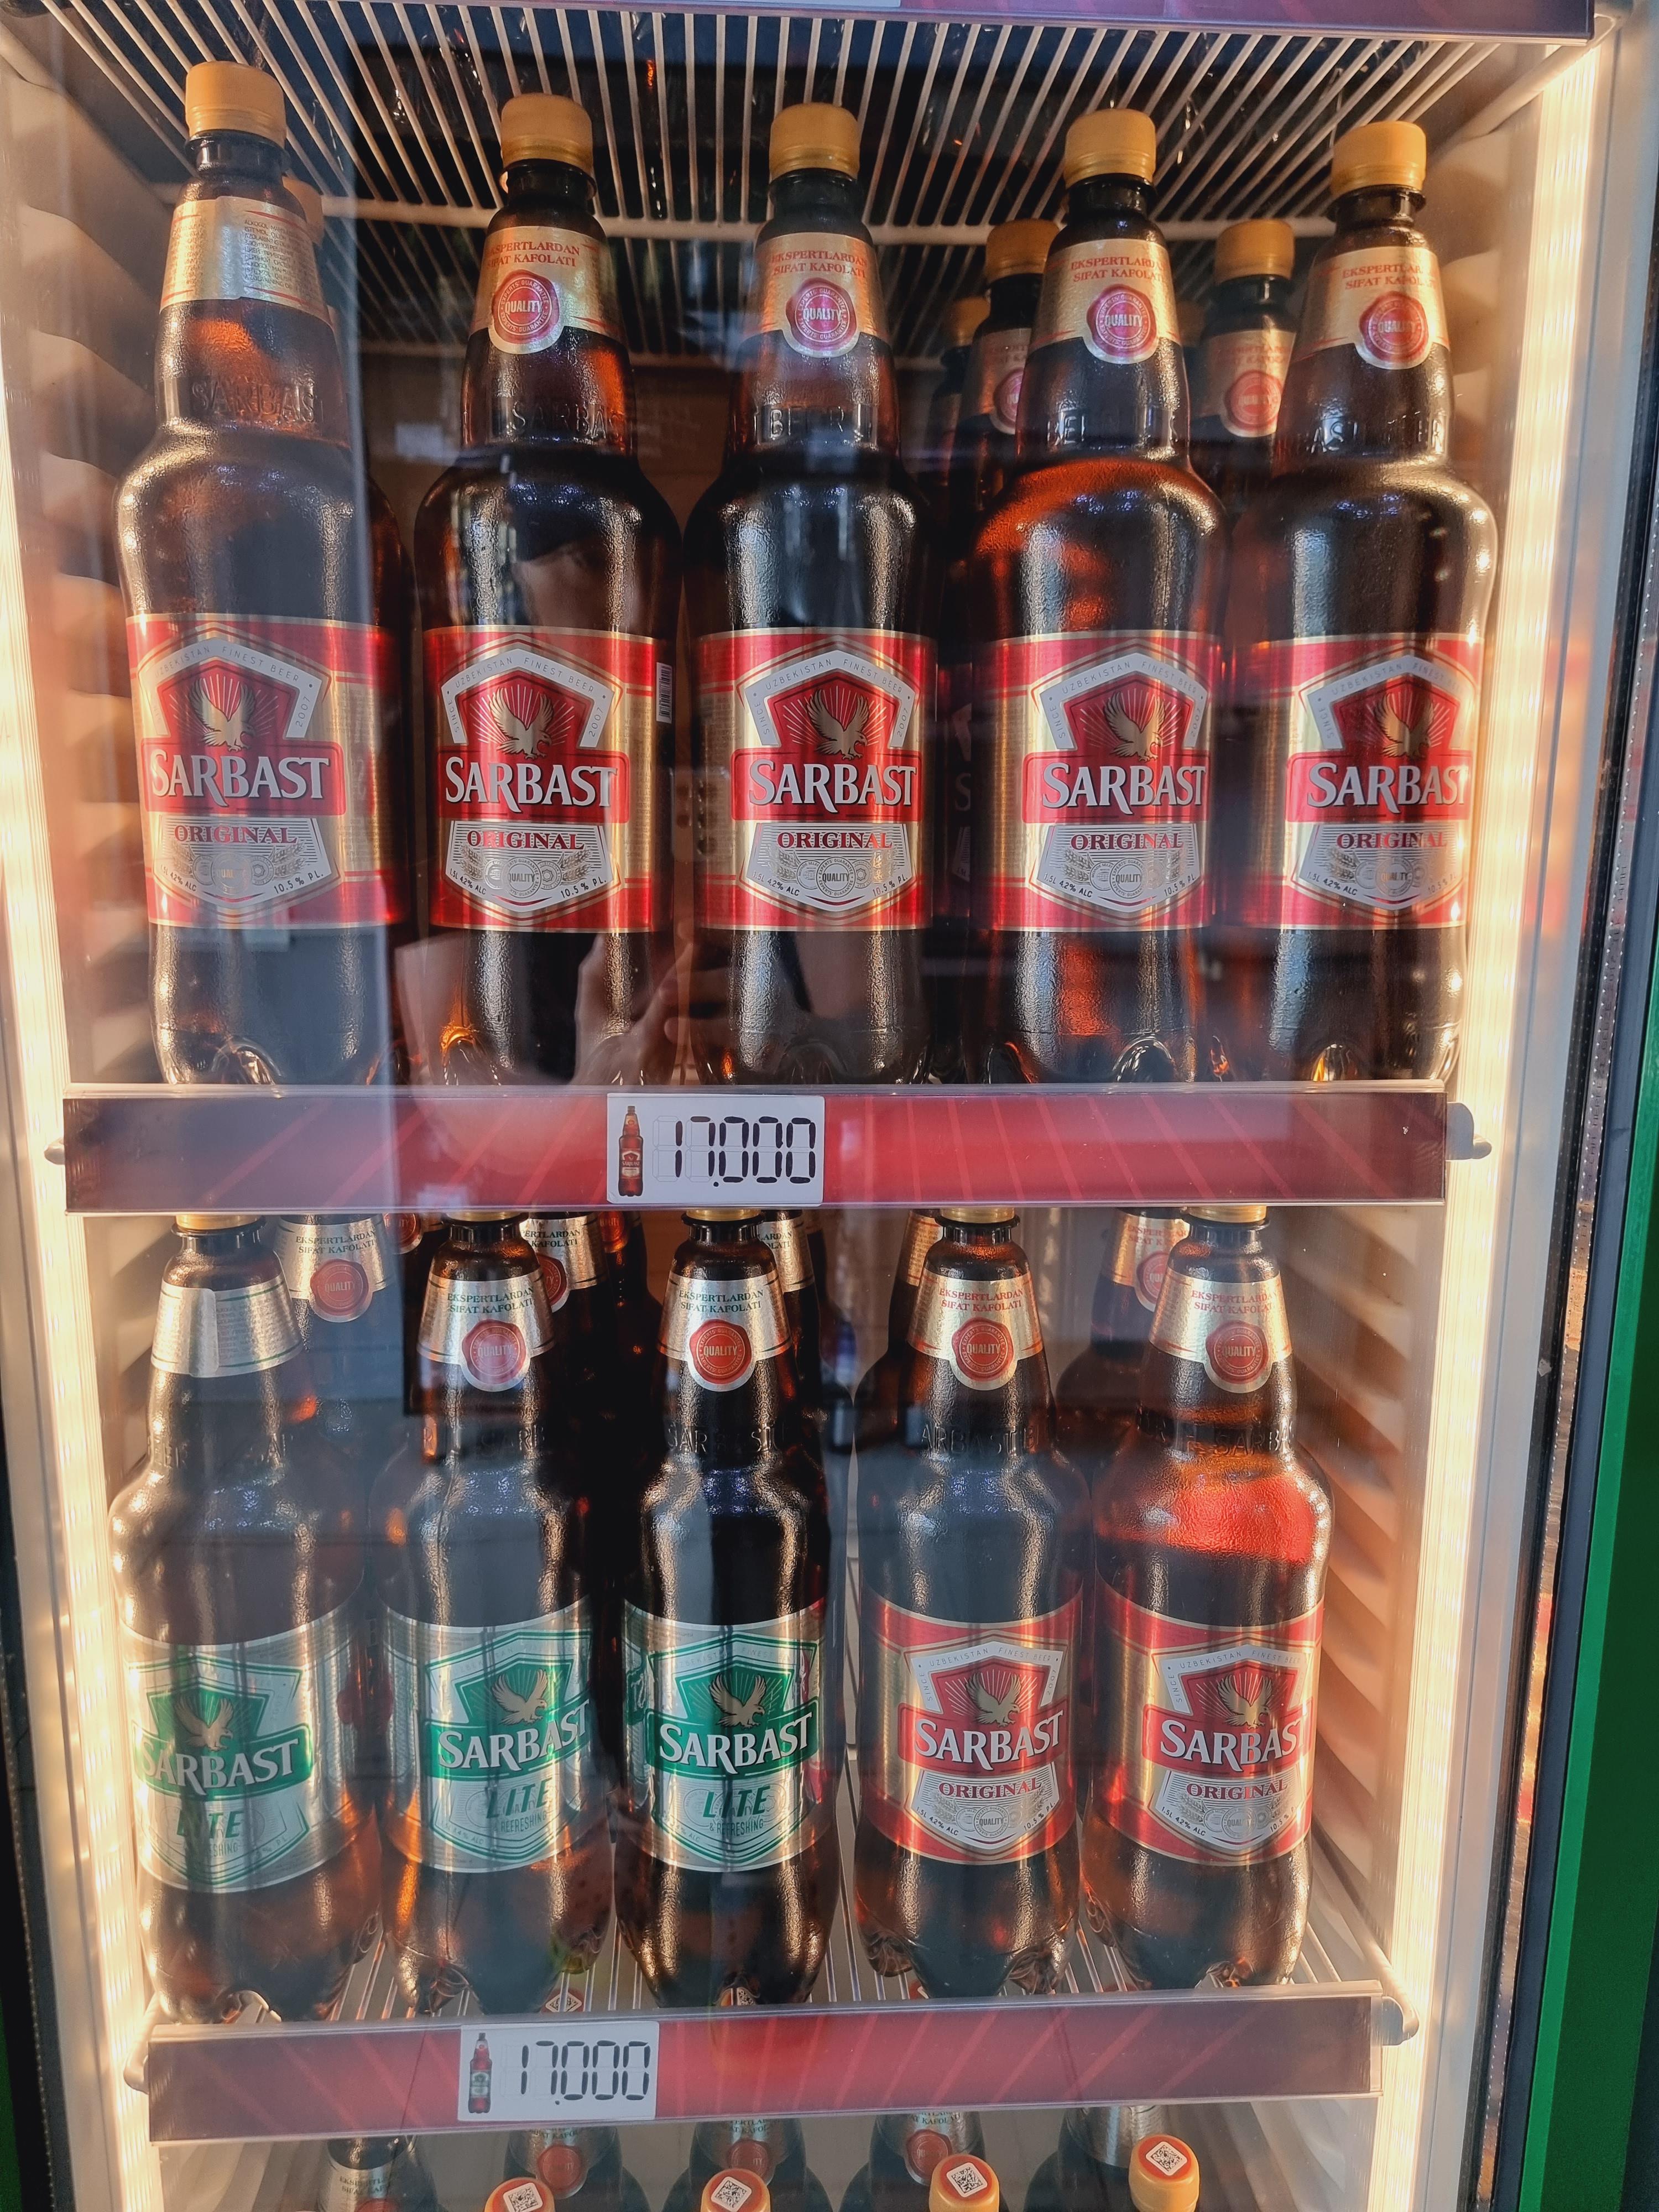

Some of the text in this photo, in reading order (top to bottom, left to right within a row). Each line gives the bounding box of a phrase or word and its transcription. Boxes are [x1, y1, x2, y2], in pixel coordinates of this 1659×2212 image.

[513, 253, 577, 267] KAFOLATI
[773, 262, 865, 278] SIFAT KAFOLATI
[1073, 269, 1109, 282] SIFAT
[1345, 277, 1381, 290] SIFAT
[521, 280, 550, 304] GUARANTEE
[504, 300, 544, 315] QUALITY
[802, 307, 843, 322] QUALITY
[1104, 314, 1144, 328] QUALITY
[154, 646, 300, 682] UZBEKISTAN FINEST BEER
[455, 657, 594, 693] UZBEKISTAN FINEST BEER
[765, 659, 903, 693] UZBEKISTAN FINEST BEER
[1062, 661, 1130, 695] UZBEKISTAN
[1141, 661, 1176, 680] FINEST
[1331, 664, 1403, 695] UZBEKISTAN
[294, 696, 311, 728] 2007
[447, 699, 461, 733] SINCE
[753, 702, 771, 735] SINCE
[588, 708, 604, 738] 2007
[896, 708, 909, 737] 2007
[1050, 706, 1067, 739] SINCE
[1318, 707, 1335, 739] SINCE
[149, 748, 332, 807] SARBAST
[445, 756, 619, 813] SARBAST
[748, 758, 917, 813] SARBAST
[1041, 762, 1207, 816] SARBAST
[1306, 762, 1471, 816] SARBAST
[174, 825, 298, 844] ORIGINAL
[466, 830, 585, 850] ORIGINAL
[776, 832, 894, 849] ORIGINAL
[1070, 832, 1185, 851] ORIGINAL
[1335, 832, 1448, 849] ORIGINAL
[185, 881, 197, 892] ALC
[273, 880, 295, 895] 10.5
[294, 877, 306, 885] %
[449, 868, 459, 880] 1.5L
[474, 885, 488, 895] ALC
[507, 872, 536, 883] QUALITY
[752, 870, 801, 896] 1.5L 4.2% ALC
[821, 873, 851, 883] QUALITY
[1043, 873, 1093, 898] 1.5L 4.2% ALC
[1115, 873, 1143, 883] QUALITY
[560, 877, 607, 899] 10.5 % PL.
[872, 884, 889, 897] 10.5
[1163, 883, 1179, 897] 10.5
[1343, 885, 1359, 896] ALC
[295, 1229, 376, 1244] EKSPERTLARDAN
[531, 1239, 578, 1248] KAFOLATI
[327, 1240, 375, 1254] KAFOLATI
[447, 1287, 534, 1303] EKSPERTLARDAN
[679, 1290, 764, 1302] EKSPERTLARDAN
[938, 1288, 1024, 1301] EKSPERTLARDAN
[449, 1298, 533, 1313] SIFAT KAFOLATI
[680, 1301, 761, 1313] SIFAT KAFOLATI
[941, 1300, 1022, 1312] SIFAT KAFOLATI
[1193, 1302, 1225, 1313] SIFAT
[477, 1344, 515, 1358] QUALITY
[703, 1345, 739, 1358] QUALITY
[967, 1343, 1002, 1356] QUALITY
[1222, 1346, 1258, 1358] QUALITY
[929, 1647, 989, 1667] UZBEKISTAN
[998, 1647, 1030, 1658] FINEST
[1179, 1650, 1282, 1669] UZBEKISTAN FINEST
[919, 1671, 934, 1702] SINCE
[1168, 1674, 1183, 1703] SINCE
[437, 1699, 591, 1771] SARBAST
[659, 1712, 813, 1775] SARBAST
[914, 1710, 1063, 1771] SARBAST
[1160, 1719, 1307, 1772] SARBAST
[139, 1739, 300, 1796] SARBAST
[486, 1777, 553, 1819] LITE
[938, 1777, 1043, 1799] ORIGINAL
[1186, 1778, 1289, 1799] ORIGINAL
[702, 1785, 771, 1818] LITE
[916, 1807, 959, 1836] 1.5L 4.2% ALC
[978, 1817, 1005, 1827] QUALITY
[1023, 1818, 1038, 1832] 10.5
[1046, 1802, 1056, 1812] PL.
[1161, 1806, 1207, 1836] 1.5L 4.2% ALC
[1269, 1819, 1284, 1832] 10.5
[716, 1819, 765, 1837] REFRESHING
